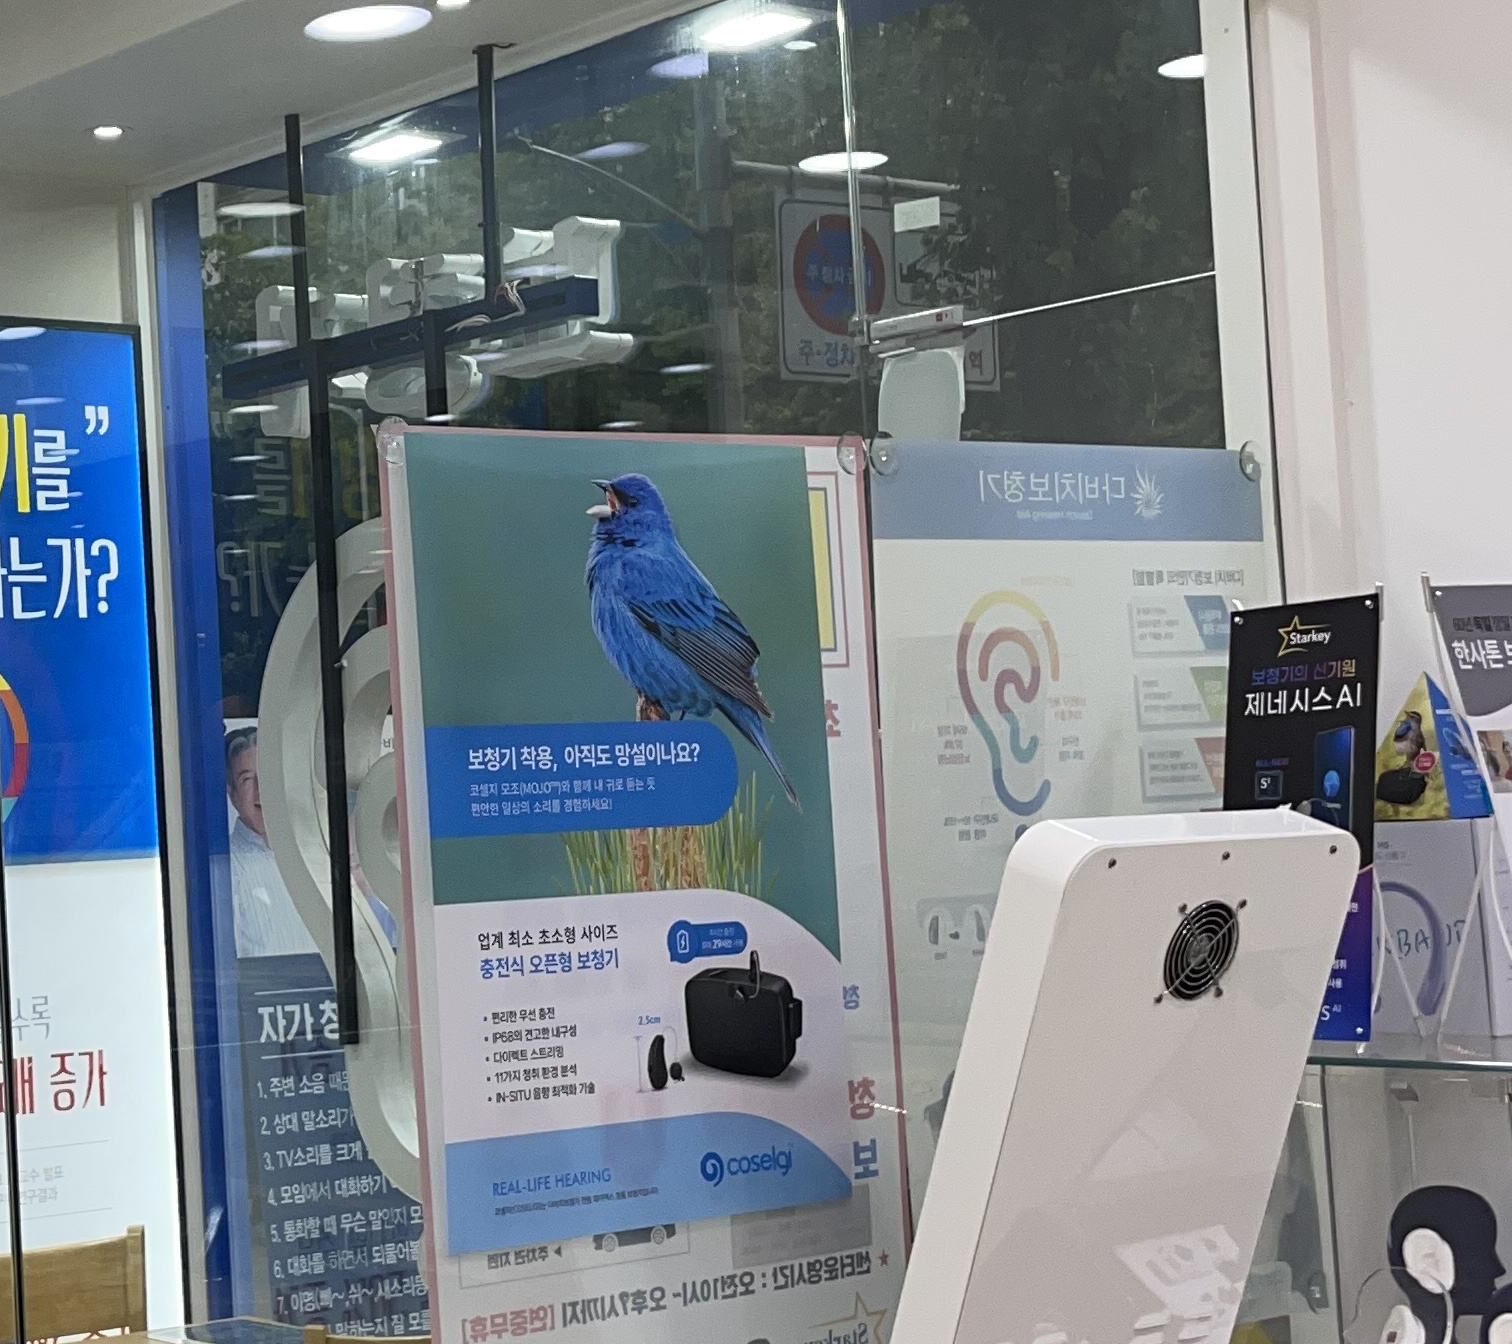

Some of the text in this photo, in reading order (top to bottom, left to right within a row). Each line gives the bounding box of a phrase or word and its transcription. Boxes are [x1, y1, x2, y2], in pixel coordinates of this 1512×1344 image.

[1289, 630, 1332, 645] Starkey
[1451, 638, 1504, 670] 한사톤
[1251, 659, 1356, 686] 보청기의 신기원
[468, 741, 700, 772] 보청기 착용, 아직도 망설이나요?
[478, 924, 618, 951] 업계 최소 초소형 사이즈
[480, 948, 619, 980] 충전식 오픈형 보청기
[257, 1003, 314, 1043] 자가
[519, 1008, 536, 1022] 무선
[551, 1024, 577, 1038] 내구성
[50, 1050, 108, 1111] 증가
[257, 1082, 268, 1099] 1.
[269, 1077, 295, 1098] 주변
[299, 1073, 325, 1094] 소음
[273, 1112, 299, 1135] 상대
[276, 1143, 332, 1168] TV소리를
[336, 1141, 363, 1161] 크게
[727, 1144, 793, 1177] coselgi
[280, 1180, 331, 1204] 모임에서
[335, 1174, 387, 1198] 대화하기
[492, 1167, 612, 1197] REAL-LIFE HEARING
[270, 1224, 281, 1243] 5.
[283, 1216, 320, 1242] 통화할
[324, 1214, 337, 1235] 때
[340, 1211, 366, 1233] 무슨
[369, 1206, 407, 1230] 말인지
[273, 1260, 285, 1279] 6.
[287, 1253, 325, 1275] 대화를
[328, 1246, 369, 1270] 하면서
[277, 1297, 288, 1315] 7.
